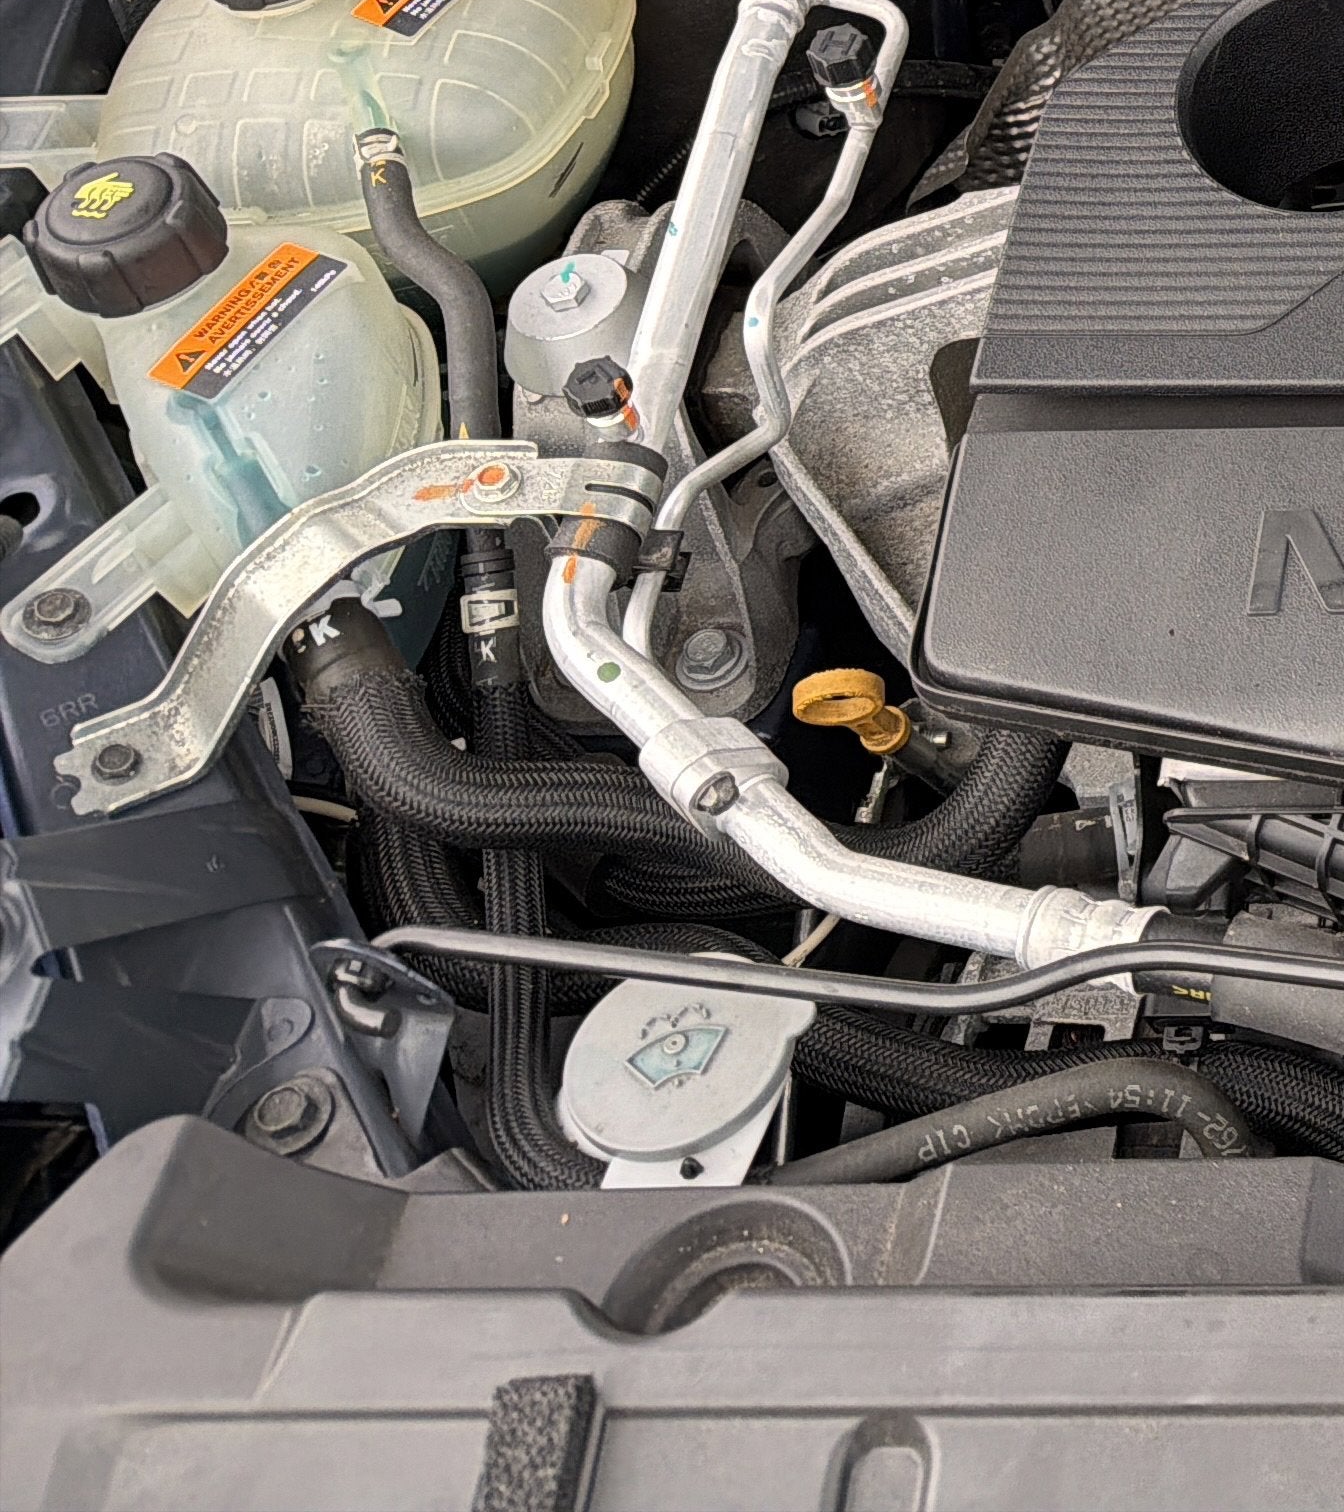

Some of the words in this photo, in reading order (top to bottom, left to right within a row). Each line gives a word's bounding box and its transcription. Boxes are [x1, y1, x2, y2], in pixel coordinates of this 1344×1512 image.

[192, 287, 252, 339] WARNING
[205, 256, 302, 344] AVERTISSEMENT
[309, 615, 340, 646] K
